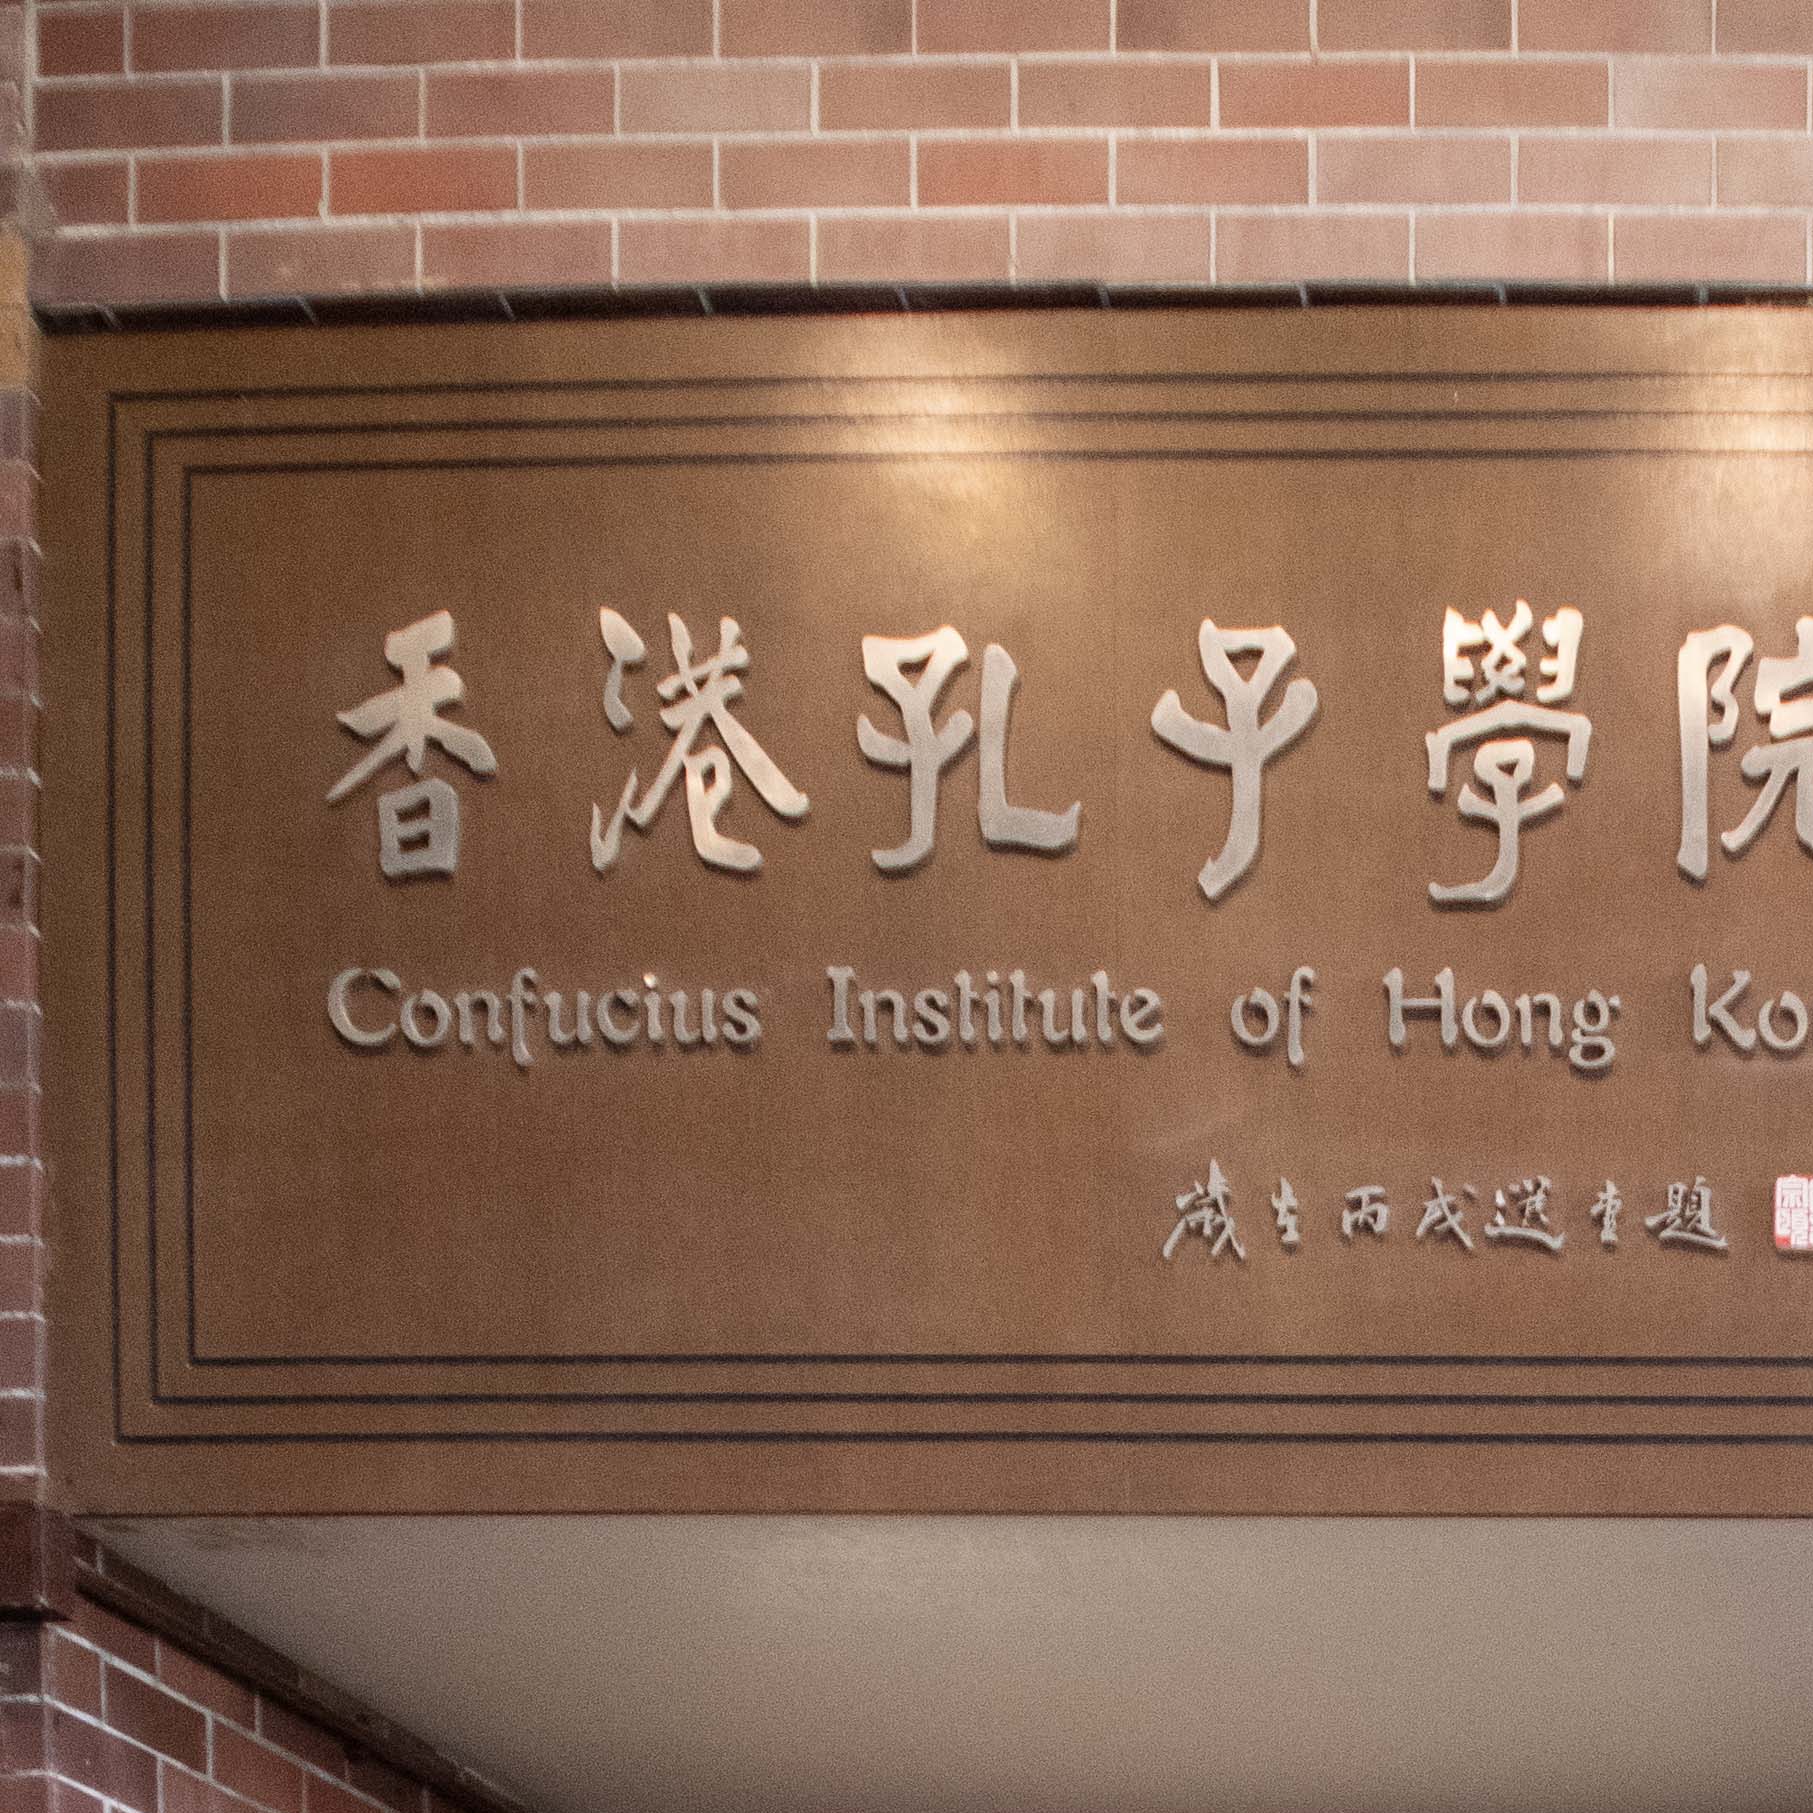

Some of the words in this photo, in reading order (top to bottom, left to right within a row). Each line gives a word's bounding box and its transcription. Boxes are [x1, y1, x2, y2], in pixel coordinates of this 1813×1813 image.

[327, 967, 763, 1067] Confucius
[825, 966, 1165, 1046] Institute
[1230, 966, 1316, 1067] of
[1383, 967, 1621, 1070] Hong
